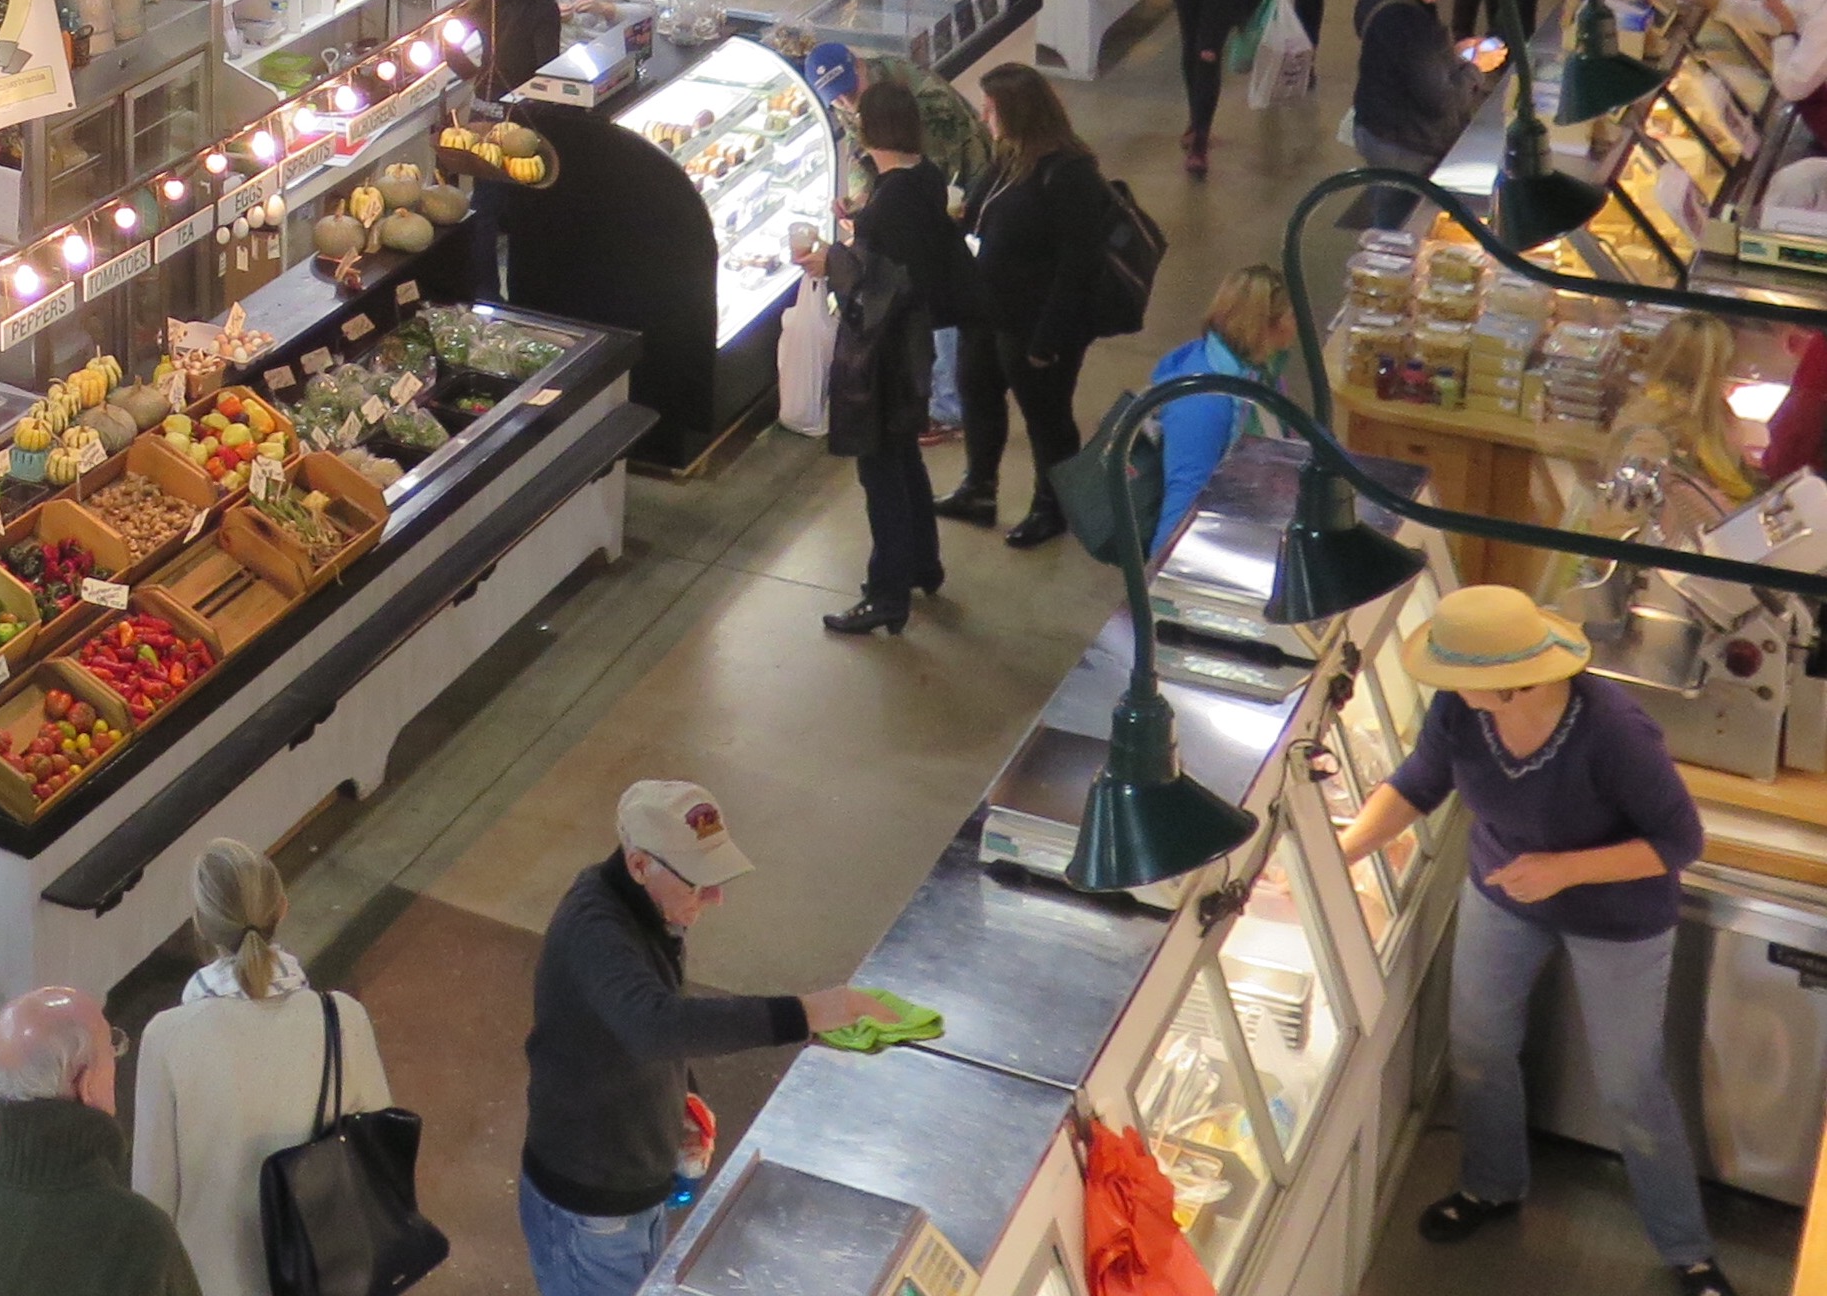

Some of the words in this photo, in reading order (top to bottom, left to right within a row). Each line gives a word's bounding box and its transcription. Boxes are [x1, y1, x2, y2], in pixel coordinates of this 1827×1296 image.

[409, 77, 438, 104] HERBS
[284, 143, 333, 181] SPROUTS
[235, 181, 264, 213] EGGS
[177, 225, 195, 244] TEA
[89, 249, 149, 297] TOMATOES
[11, 294, 68, 342] PEPPERS
